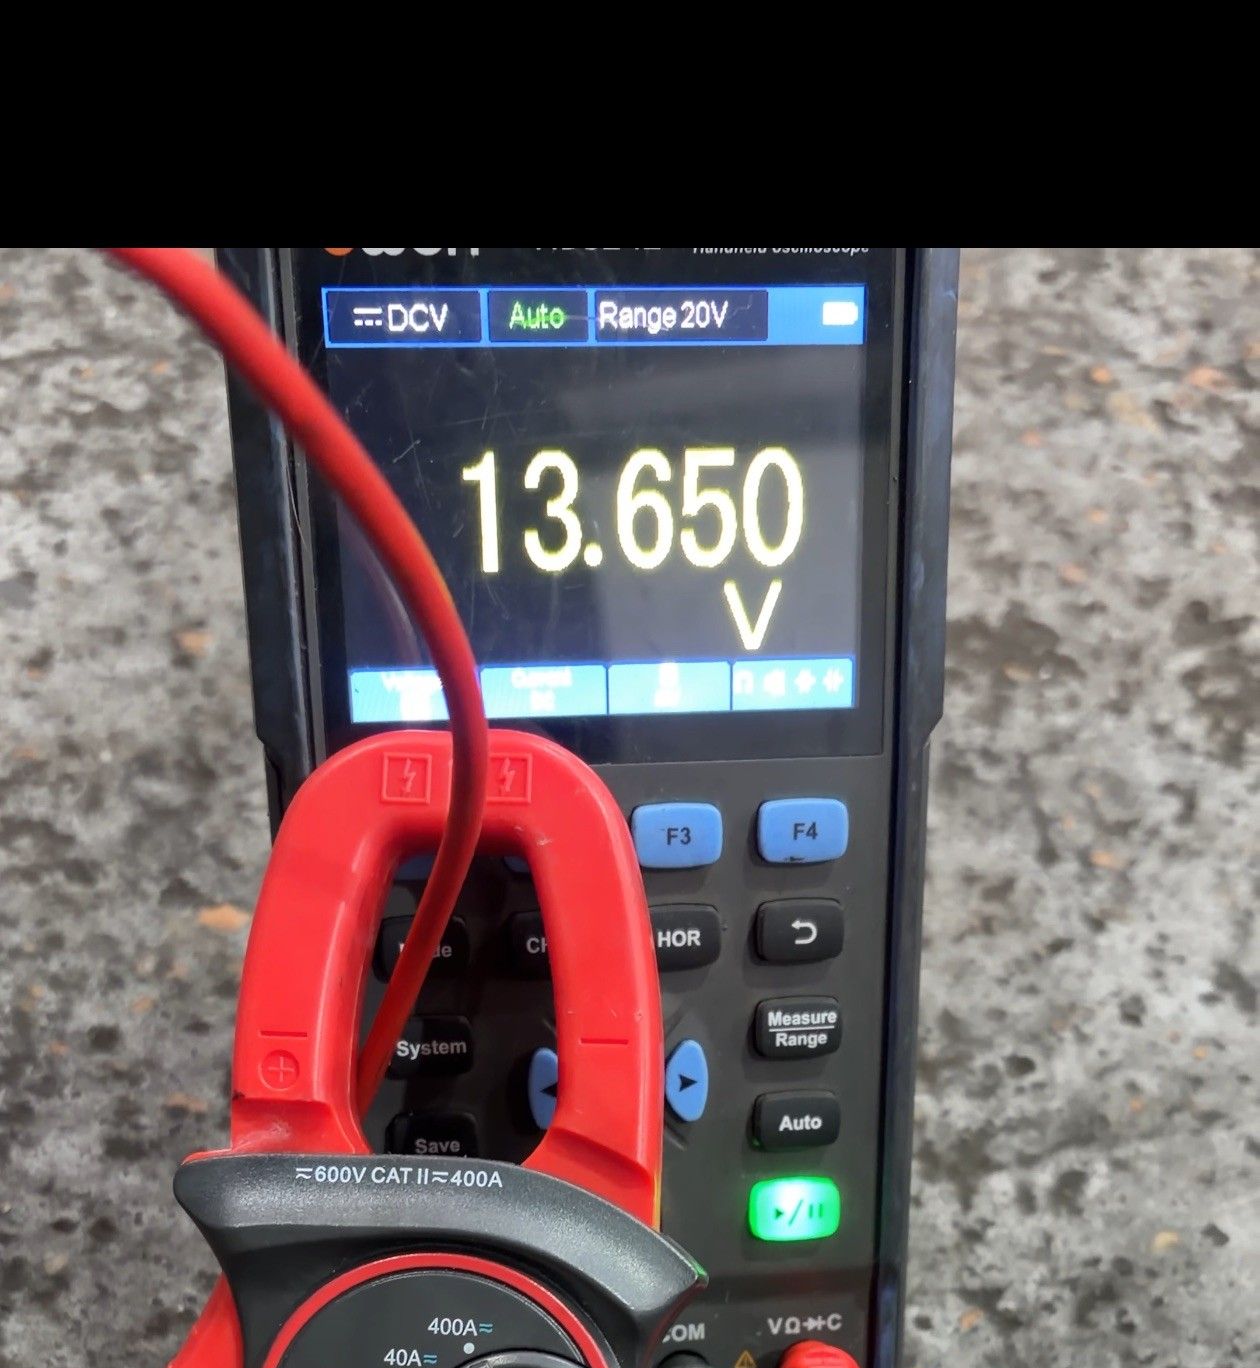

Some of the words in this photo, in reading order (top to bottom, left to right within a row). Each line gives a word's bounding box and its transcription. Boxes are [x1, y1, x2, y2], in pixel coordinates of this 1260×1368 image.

[387, 303, 448, 332] DCV
[509, 301, 567, 330] Auto
[599, 301, 676, 335] Range
[681, 301, 729, 330] 20V
[462, 446, 804, 573] 13.650
[724, 579, 783, 650] V
[666, 827, 692, 846] F3
[793, 822, 818, 840] F4
[657, 930, 701, 948] HOR
[768, 1010, 838, 1027] Measure
[396, 1039, 467, 1060] System
[775, 1032, 828, 1049] Range
[779, 1114, 823, 1132] Auto
[415, 1138, 461, 1154] Save
[371, 1166, 413, 1184] CAT
